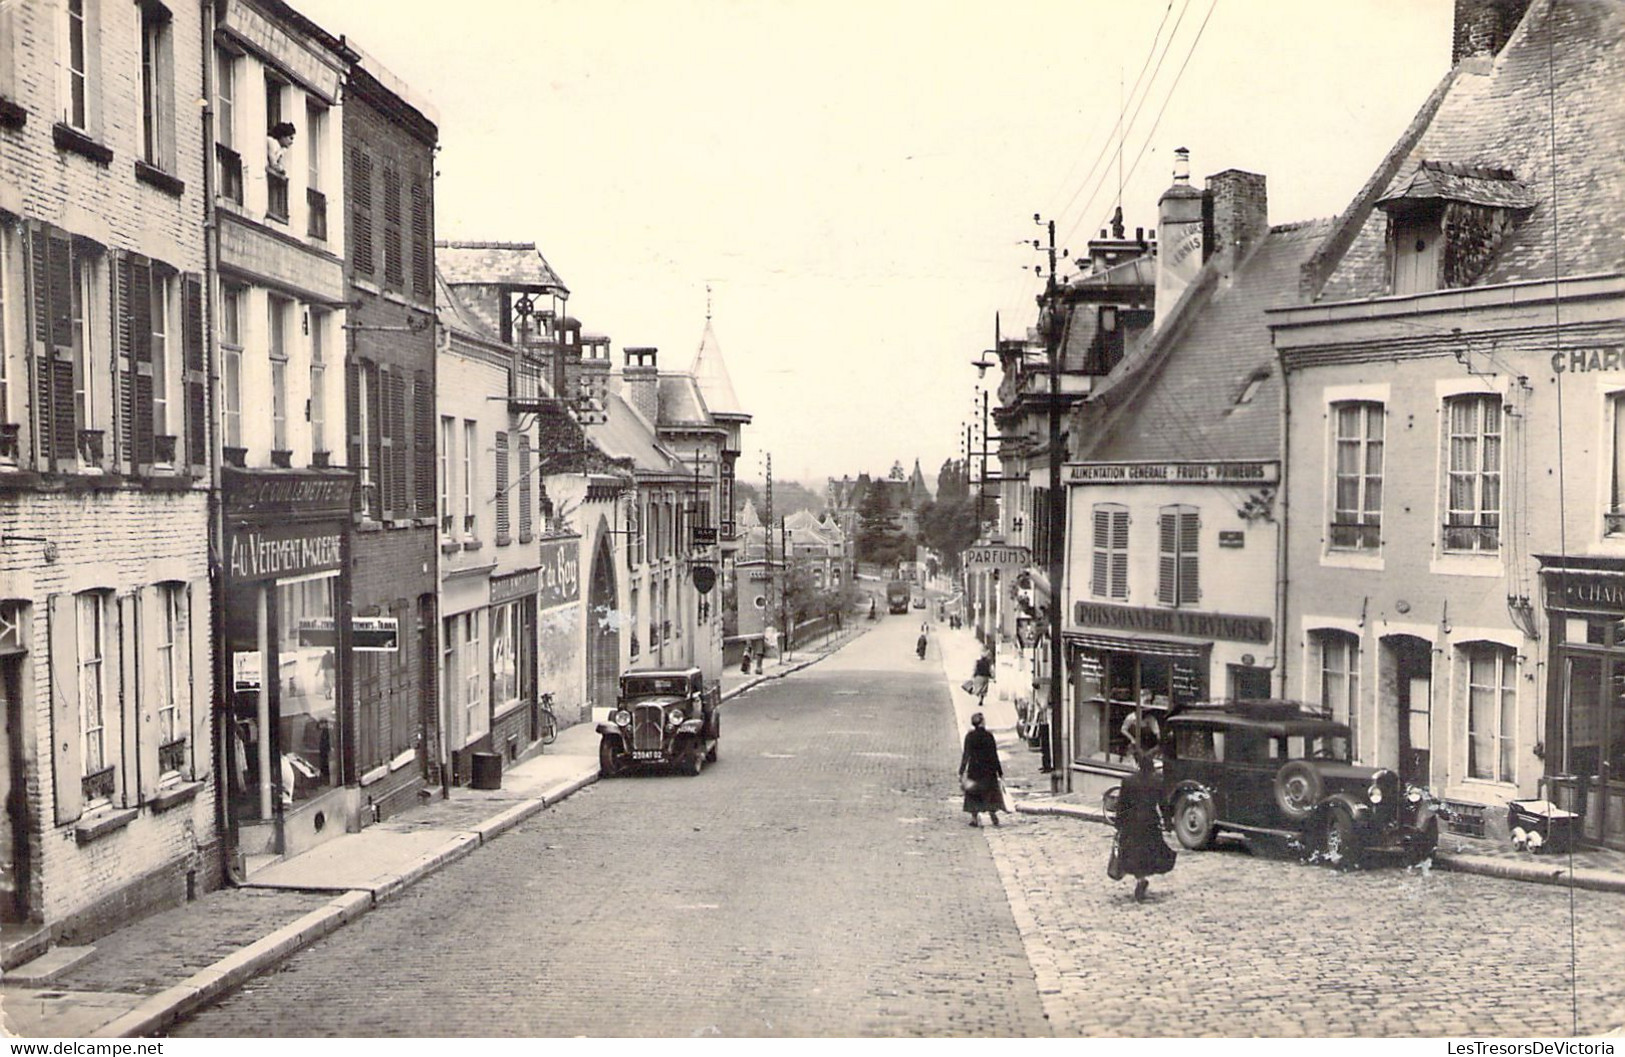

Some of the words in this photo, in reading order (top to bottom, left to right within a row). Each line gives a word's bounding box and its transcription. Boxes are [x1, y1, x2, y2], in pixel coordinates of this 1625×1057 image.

[1551, 350, 1625, 374] CHAR
[1071, 466, 1124, 479] ALIMENTATION
[1177, 466, 1208, 478] FRUITS
[301, 535, 341, 568] MODERNE
[968, 550, 1026, 564] PARFUMS
[557, 545, 577, 598] Roy
[1079, 603, 1173, 634] POISSONNERIE
[1177, 613, 1267, 641] VERVINOISE
